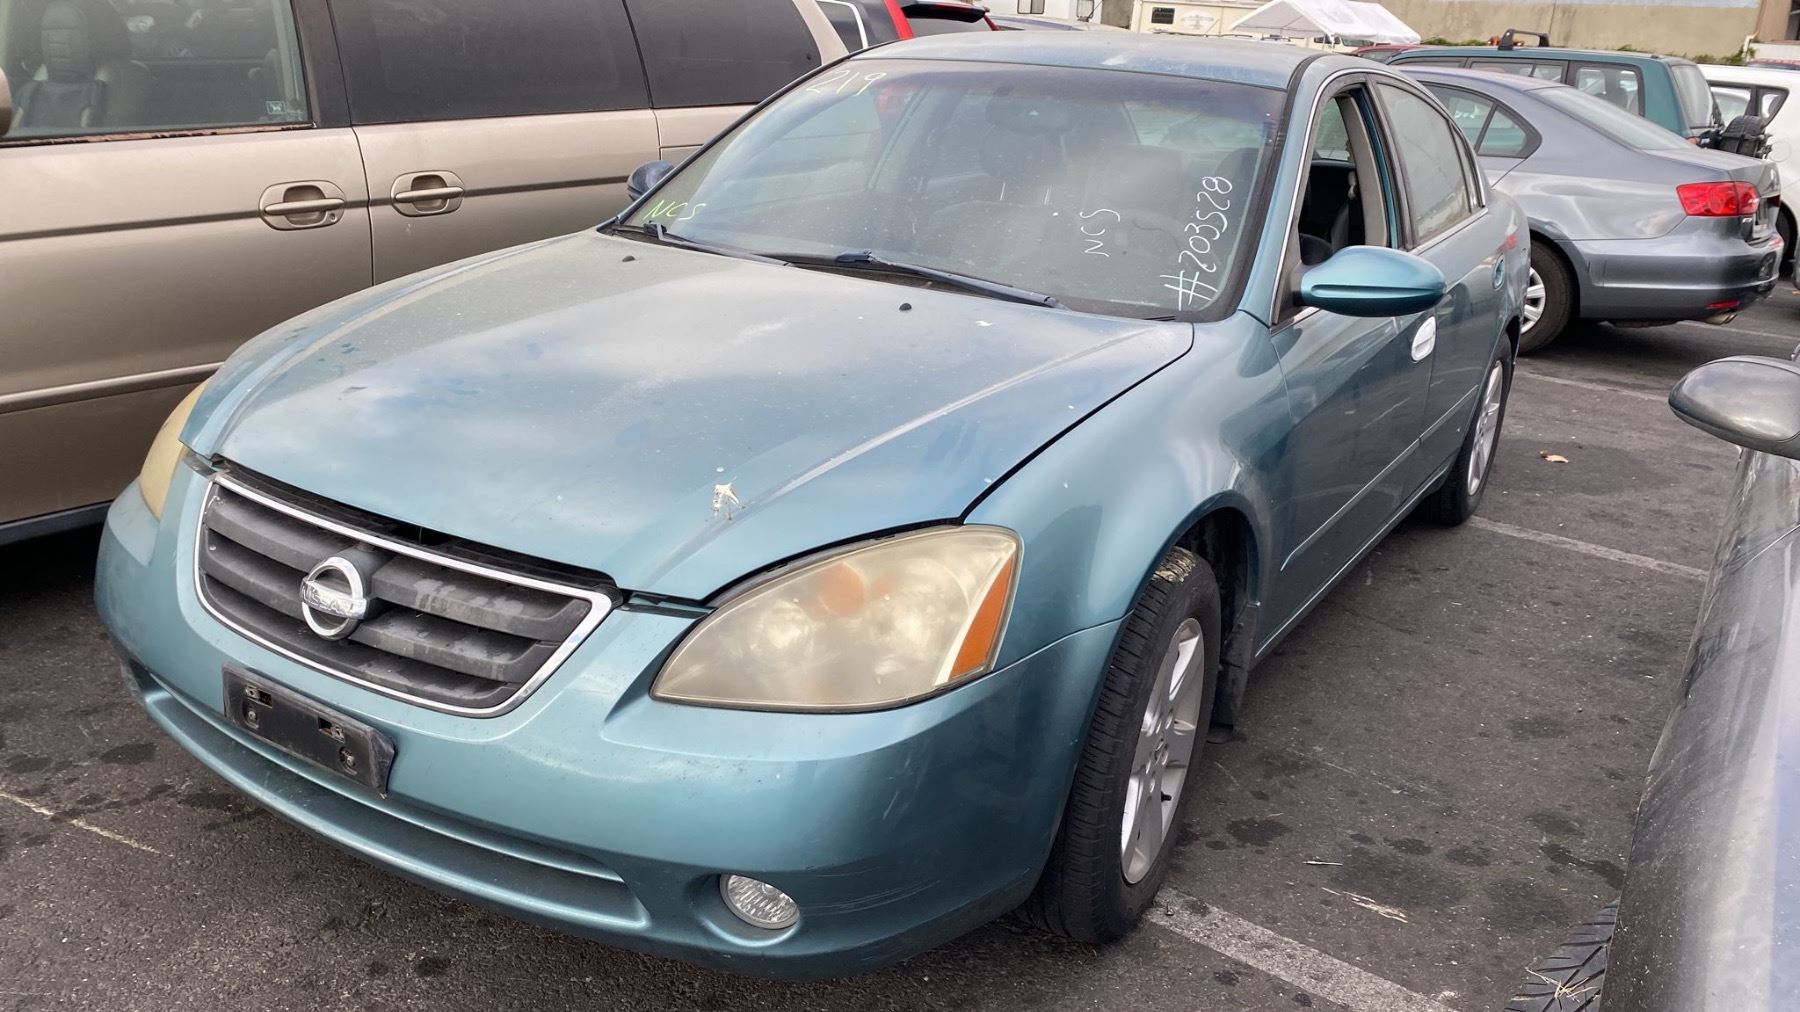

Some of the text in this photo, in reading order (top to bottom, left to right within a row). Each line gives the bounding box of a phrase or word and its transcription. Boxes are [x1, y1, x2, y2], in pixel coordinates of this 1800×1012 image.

[806, 69, 887, 97] 219
[643, 199, 706, 221] NCS
[1079, 208, 1121, 257] NCS
[1159, 176, 1233, 311] #203528
